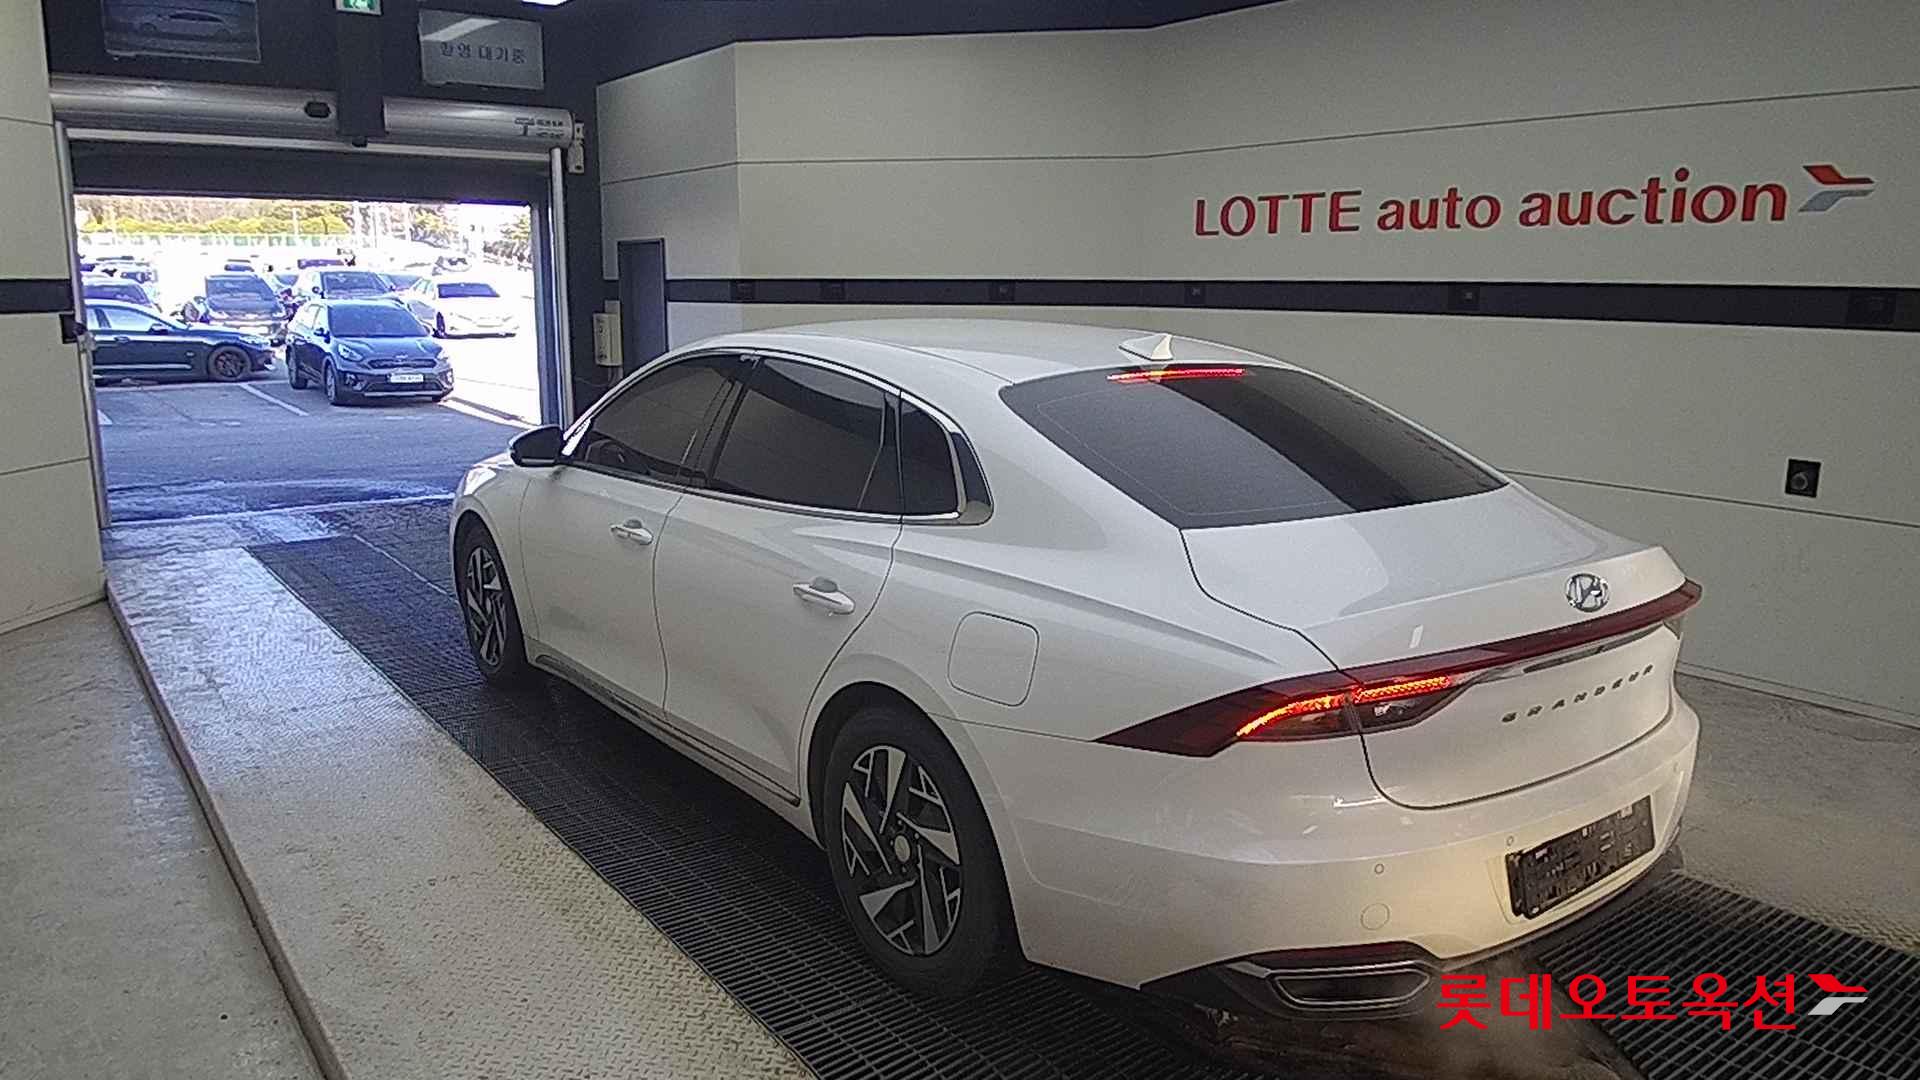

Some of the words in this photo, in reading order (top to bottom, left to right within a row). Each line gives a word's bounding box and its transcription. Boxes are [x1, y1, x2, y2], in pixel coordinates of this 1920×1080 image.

[478, 46, 527, 64] 대기중
[1195, 190, 1362, 237] LOTTE
[1377, 187, 1501, 231] auto
[1518, 166, 1788, 227] auction
